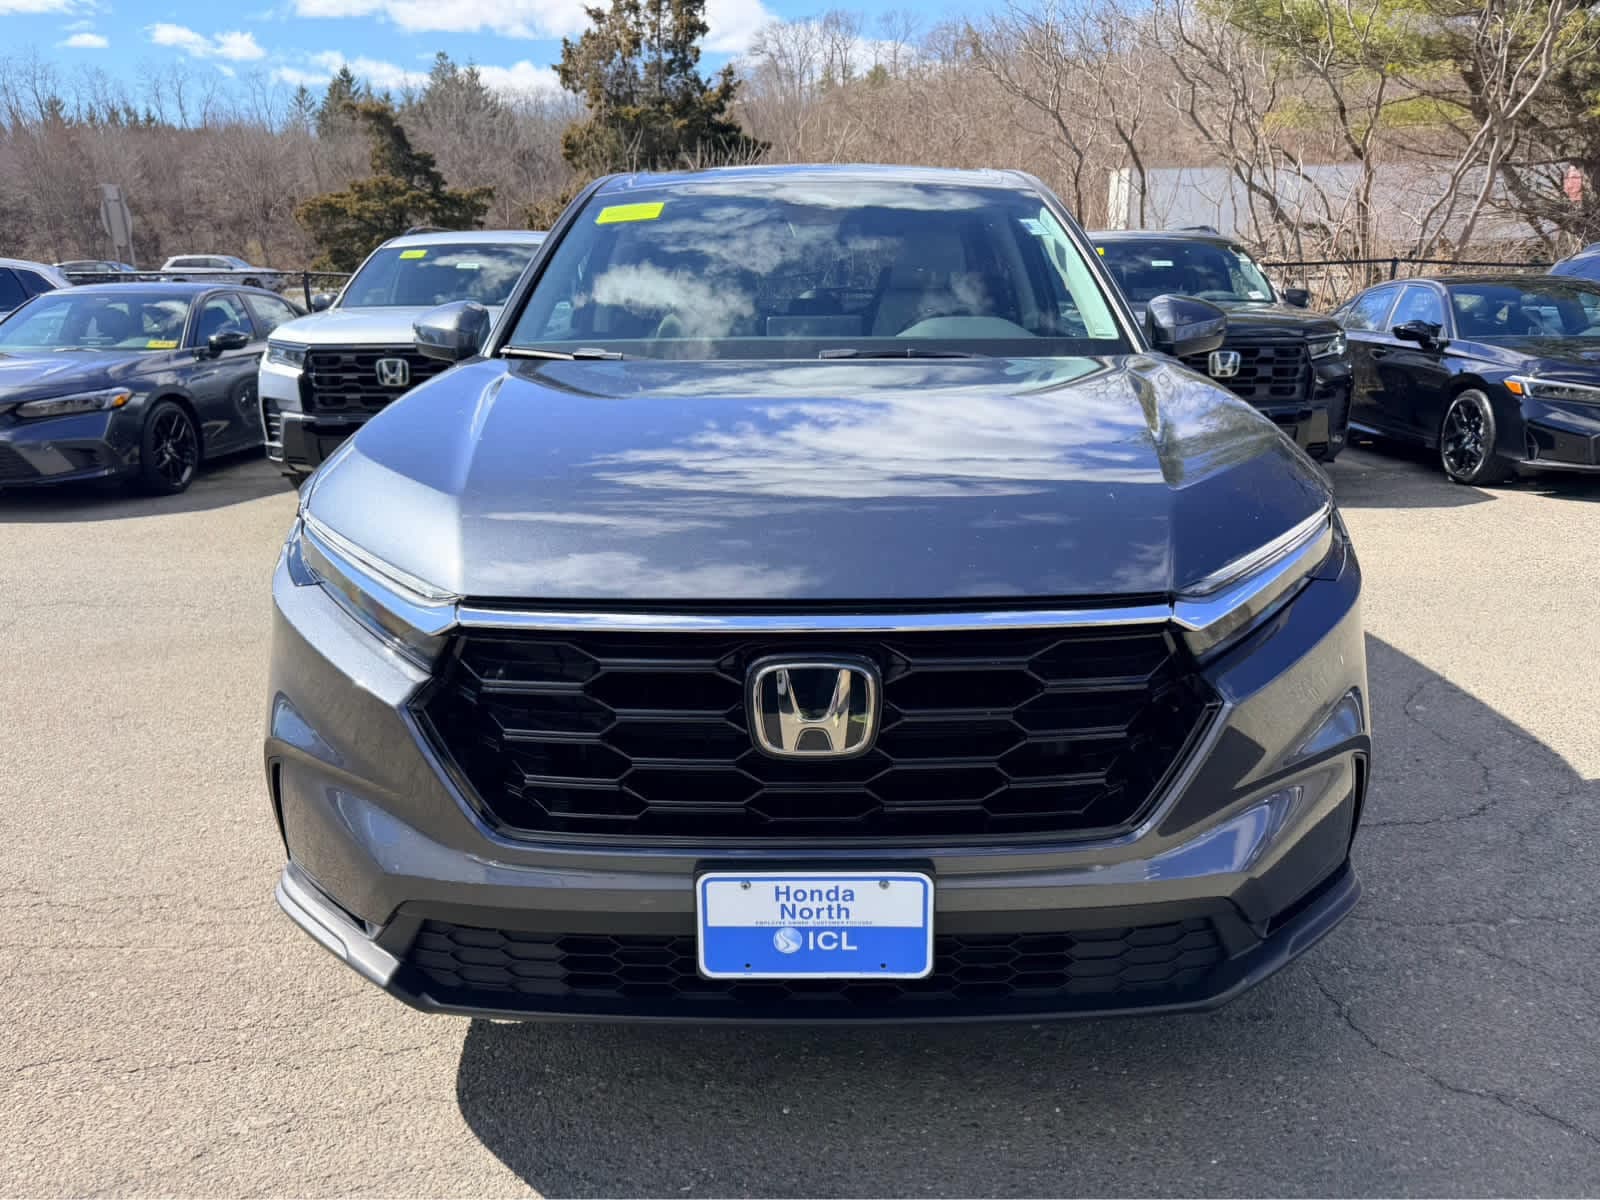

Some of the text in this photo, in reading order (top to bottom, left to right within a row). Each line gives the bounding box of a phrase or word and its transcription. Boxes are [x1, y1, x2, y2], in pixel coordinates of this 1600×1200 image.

[774, 885, 855, 902] Honda
[780, 903, 850, 920] North
[808, 931, 858, 951] ICL
